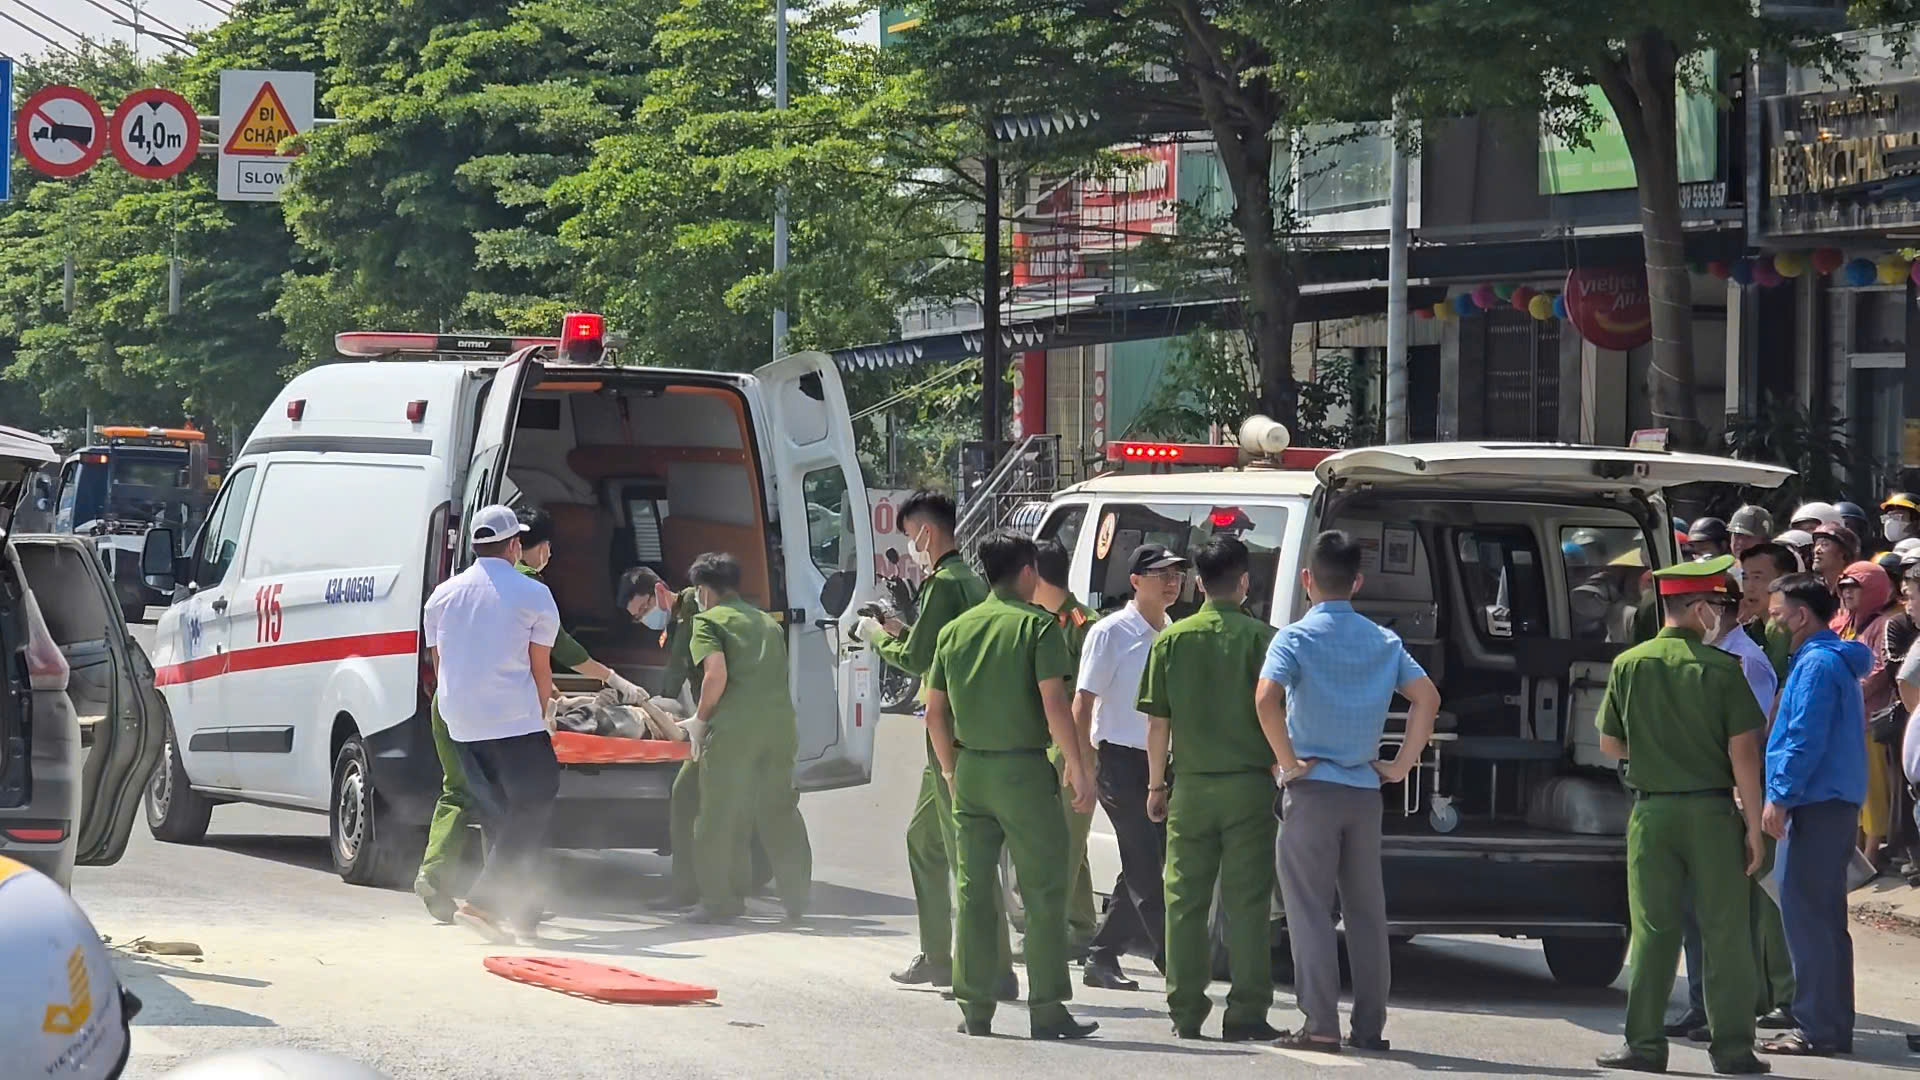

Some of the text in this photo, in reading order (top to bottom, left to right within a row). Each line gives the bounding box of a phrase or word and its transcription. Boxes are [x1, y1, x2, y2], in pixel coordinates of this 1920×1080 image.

[259, 107, 275, 121] ĐI
[128, 115, 182, 153] 4,0m
[324, 575, 375, 604] 43A-00569
[255, 583, 284, 643] 115
